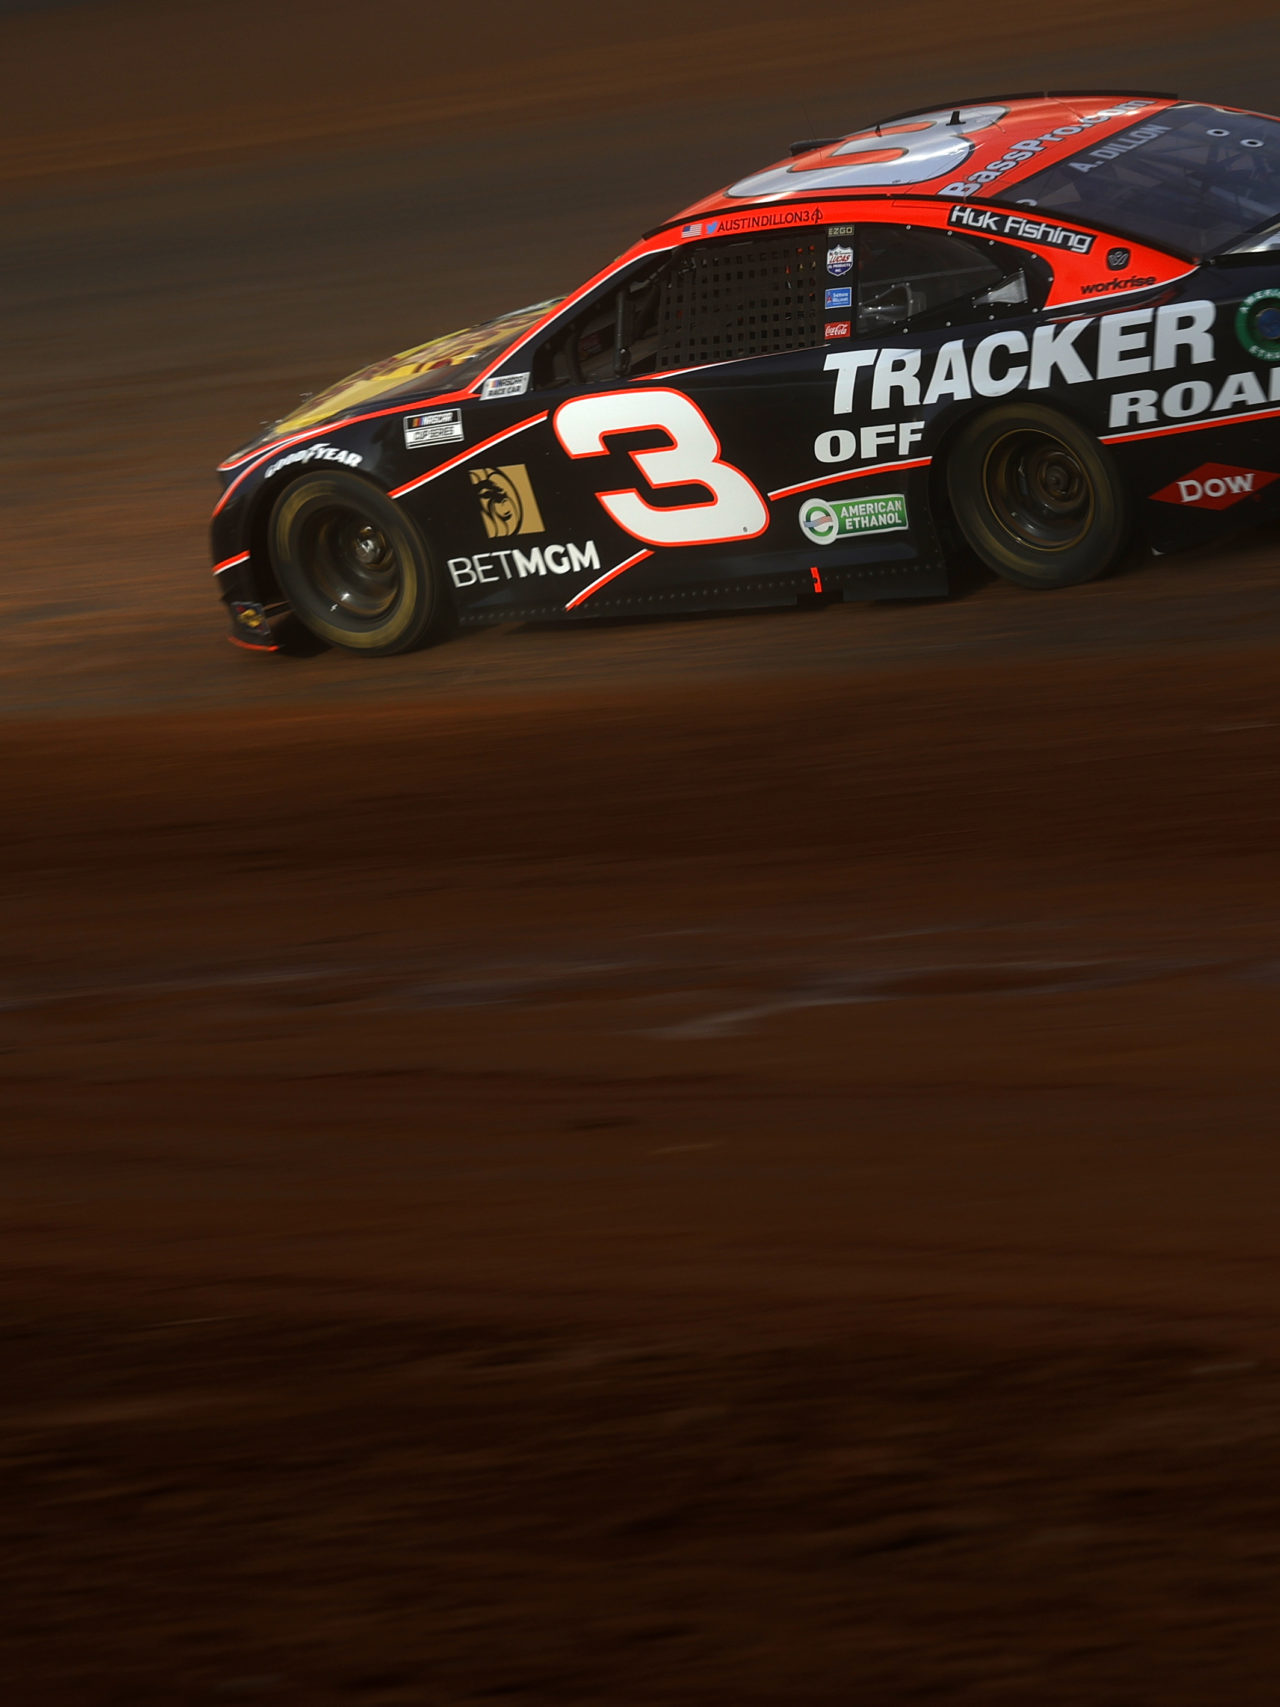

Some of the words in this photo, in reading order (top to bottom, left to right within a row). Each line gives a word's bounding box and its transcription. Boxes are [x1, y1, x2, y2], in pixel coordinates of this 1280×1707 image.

[722, 103, 1010, 199] 3
[1100, 124, 1172, 160] DILLON
[951, 206, 1000, 231] Huk
[1004, 216, 1094, 253] Fishing
[1081, 275, 1157, 295] workrise
[823, 299, 1217, 415] TRACKER
[814, 420, 926, 463] OFF
[553, 387, 769, 547] 3
[840, 500, 902, 518] AMERICAN
[845, 512, 902, 530] ETHANOL
[447, 540, 600, 588] BETMGM
